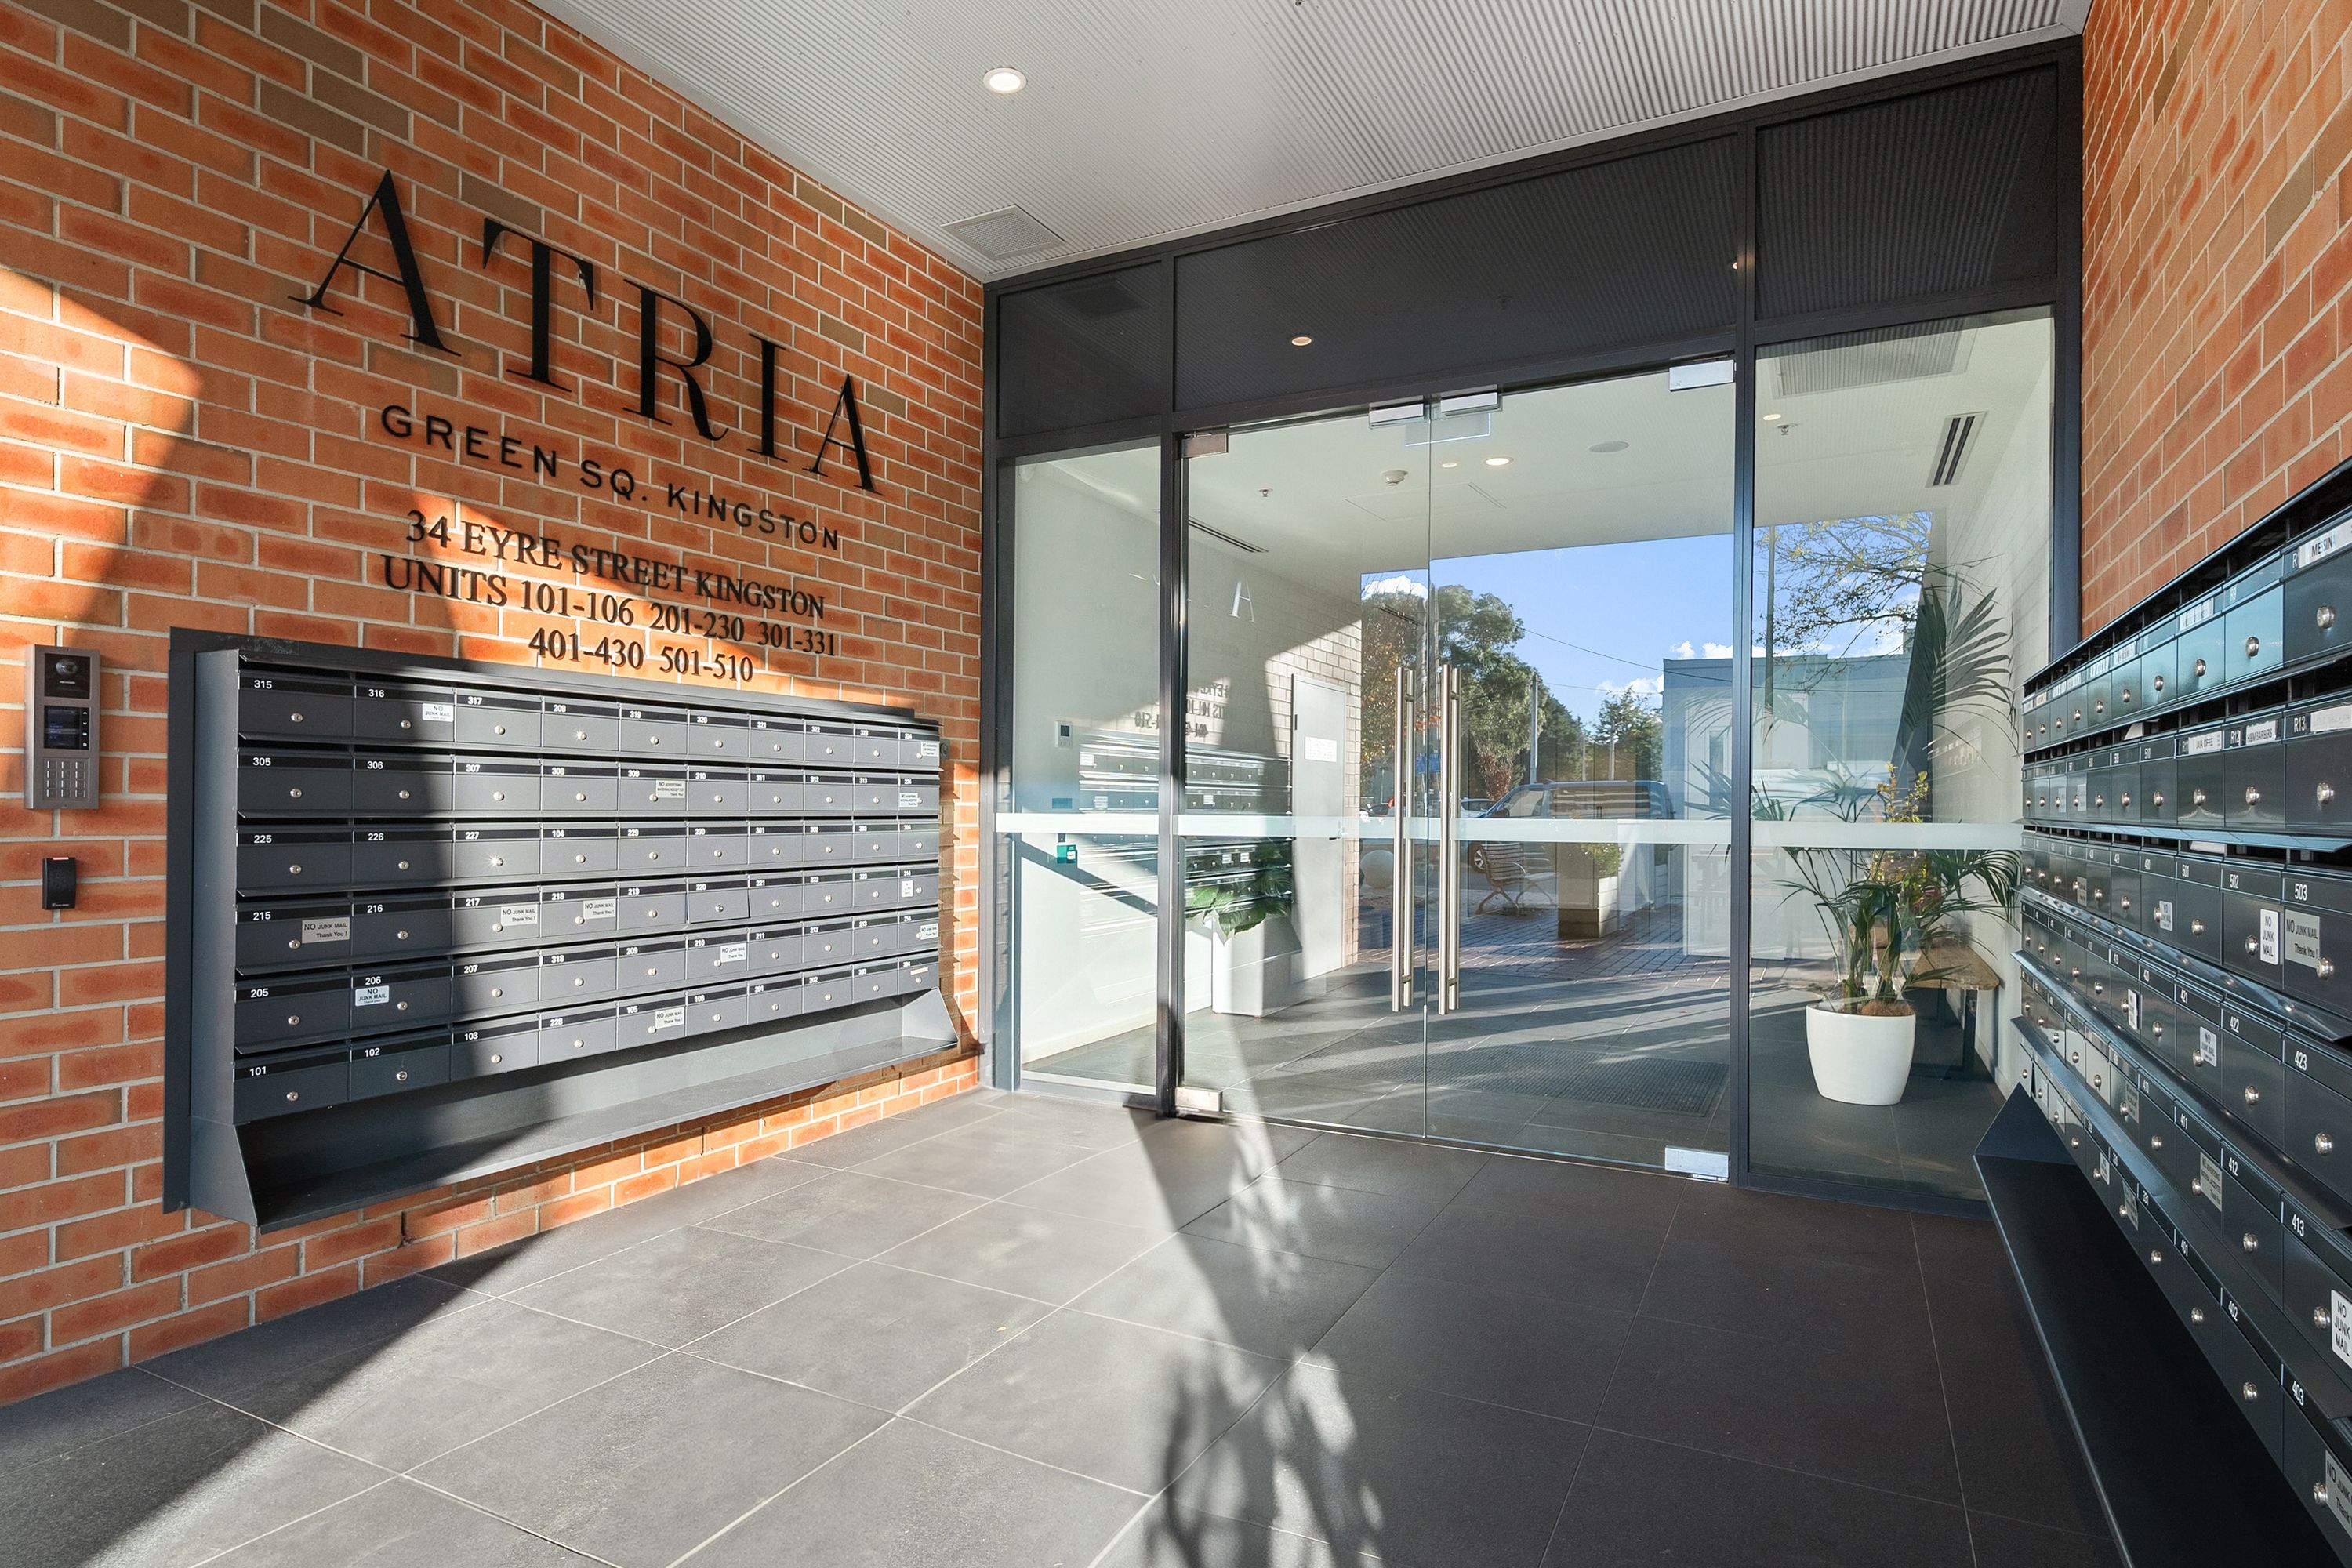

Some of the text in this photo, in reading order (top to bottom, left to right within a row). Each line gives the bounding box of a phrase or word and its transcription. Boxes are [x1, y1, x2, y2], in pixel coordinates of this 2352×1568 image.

[288, 170, 883, 495] ATRIA
[381, 405, 839, 550] GREEN SQ. KINGSTON
[406, 510, 826, 619] 34 EYRE STREET KINGSTON
[381, 554, 837, 656] UNITS 101-106 201-230 301-331
[529, 628, 753, 683] 401-430 501-510
[254, 680, 272, 689] 315
[368, 689, 384, 698] 316
[2294, 716, 2305, 732] R13
[253, 757, 271, 766] 305
[367, 761, 383, 770] 306
[368, 833, 384, 841] 226
[466, 831, 480, 840] 227
[2230, 875, 2238, 888] 502
[2295, 884, 2307, 901] 503
[367, 905, 383, 913] 216
[253, 912, 271, 920] 215
[2265, 916, 2272, 927] NO
[2286, 919, 2318, 939] NO JUNK MAIL
[2263, 932, 2274, 942] JUNK
[2263, 945, 2274, 957] MAIL
[2294, 943, 2307, 955] Thank
[551, 955, 564, 964] 318
[464, 965, 478, 974] 207
[365, 976, 382, 985] 206
[250, 989, 269, 998] 205
[2230, 1016, 2239, 1033] 422
[464, 1032, 478, 1040] 103
[365, 1048, 380, 1057] 102
[2295, 1051, 2307, 1071] 423
[249, 1066, 267, 1076] 101
[2228, 1157, 2238, 1176] 412
[2292, 1214, 2304, 1236] 413
[2228, 1301, 2238, 1322] 402
[2337, 1300, 2347, 1318] NO
[2334, 1319, 2350, 1340] JUNK
[2336, 1336, 2350, 1356] MAIL
[2292, 1381, 2304, 1406] 403
[2327, 1461, 2350, 1502] NO JUNK
[2336, 1497, 2350, 1524] Thank
